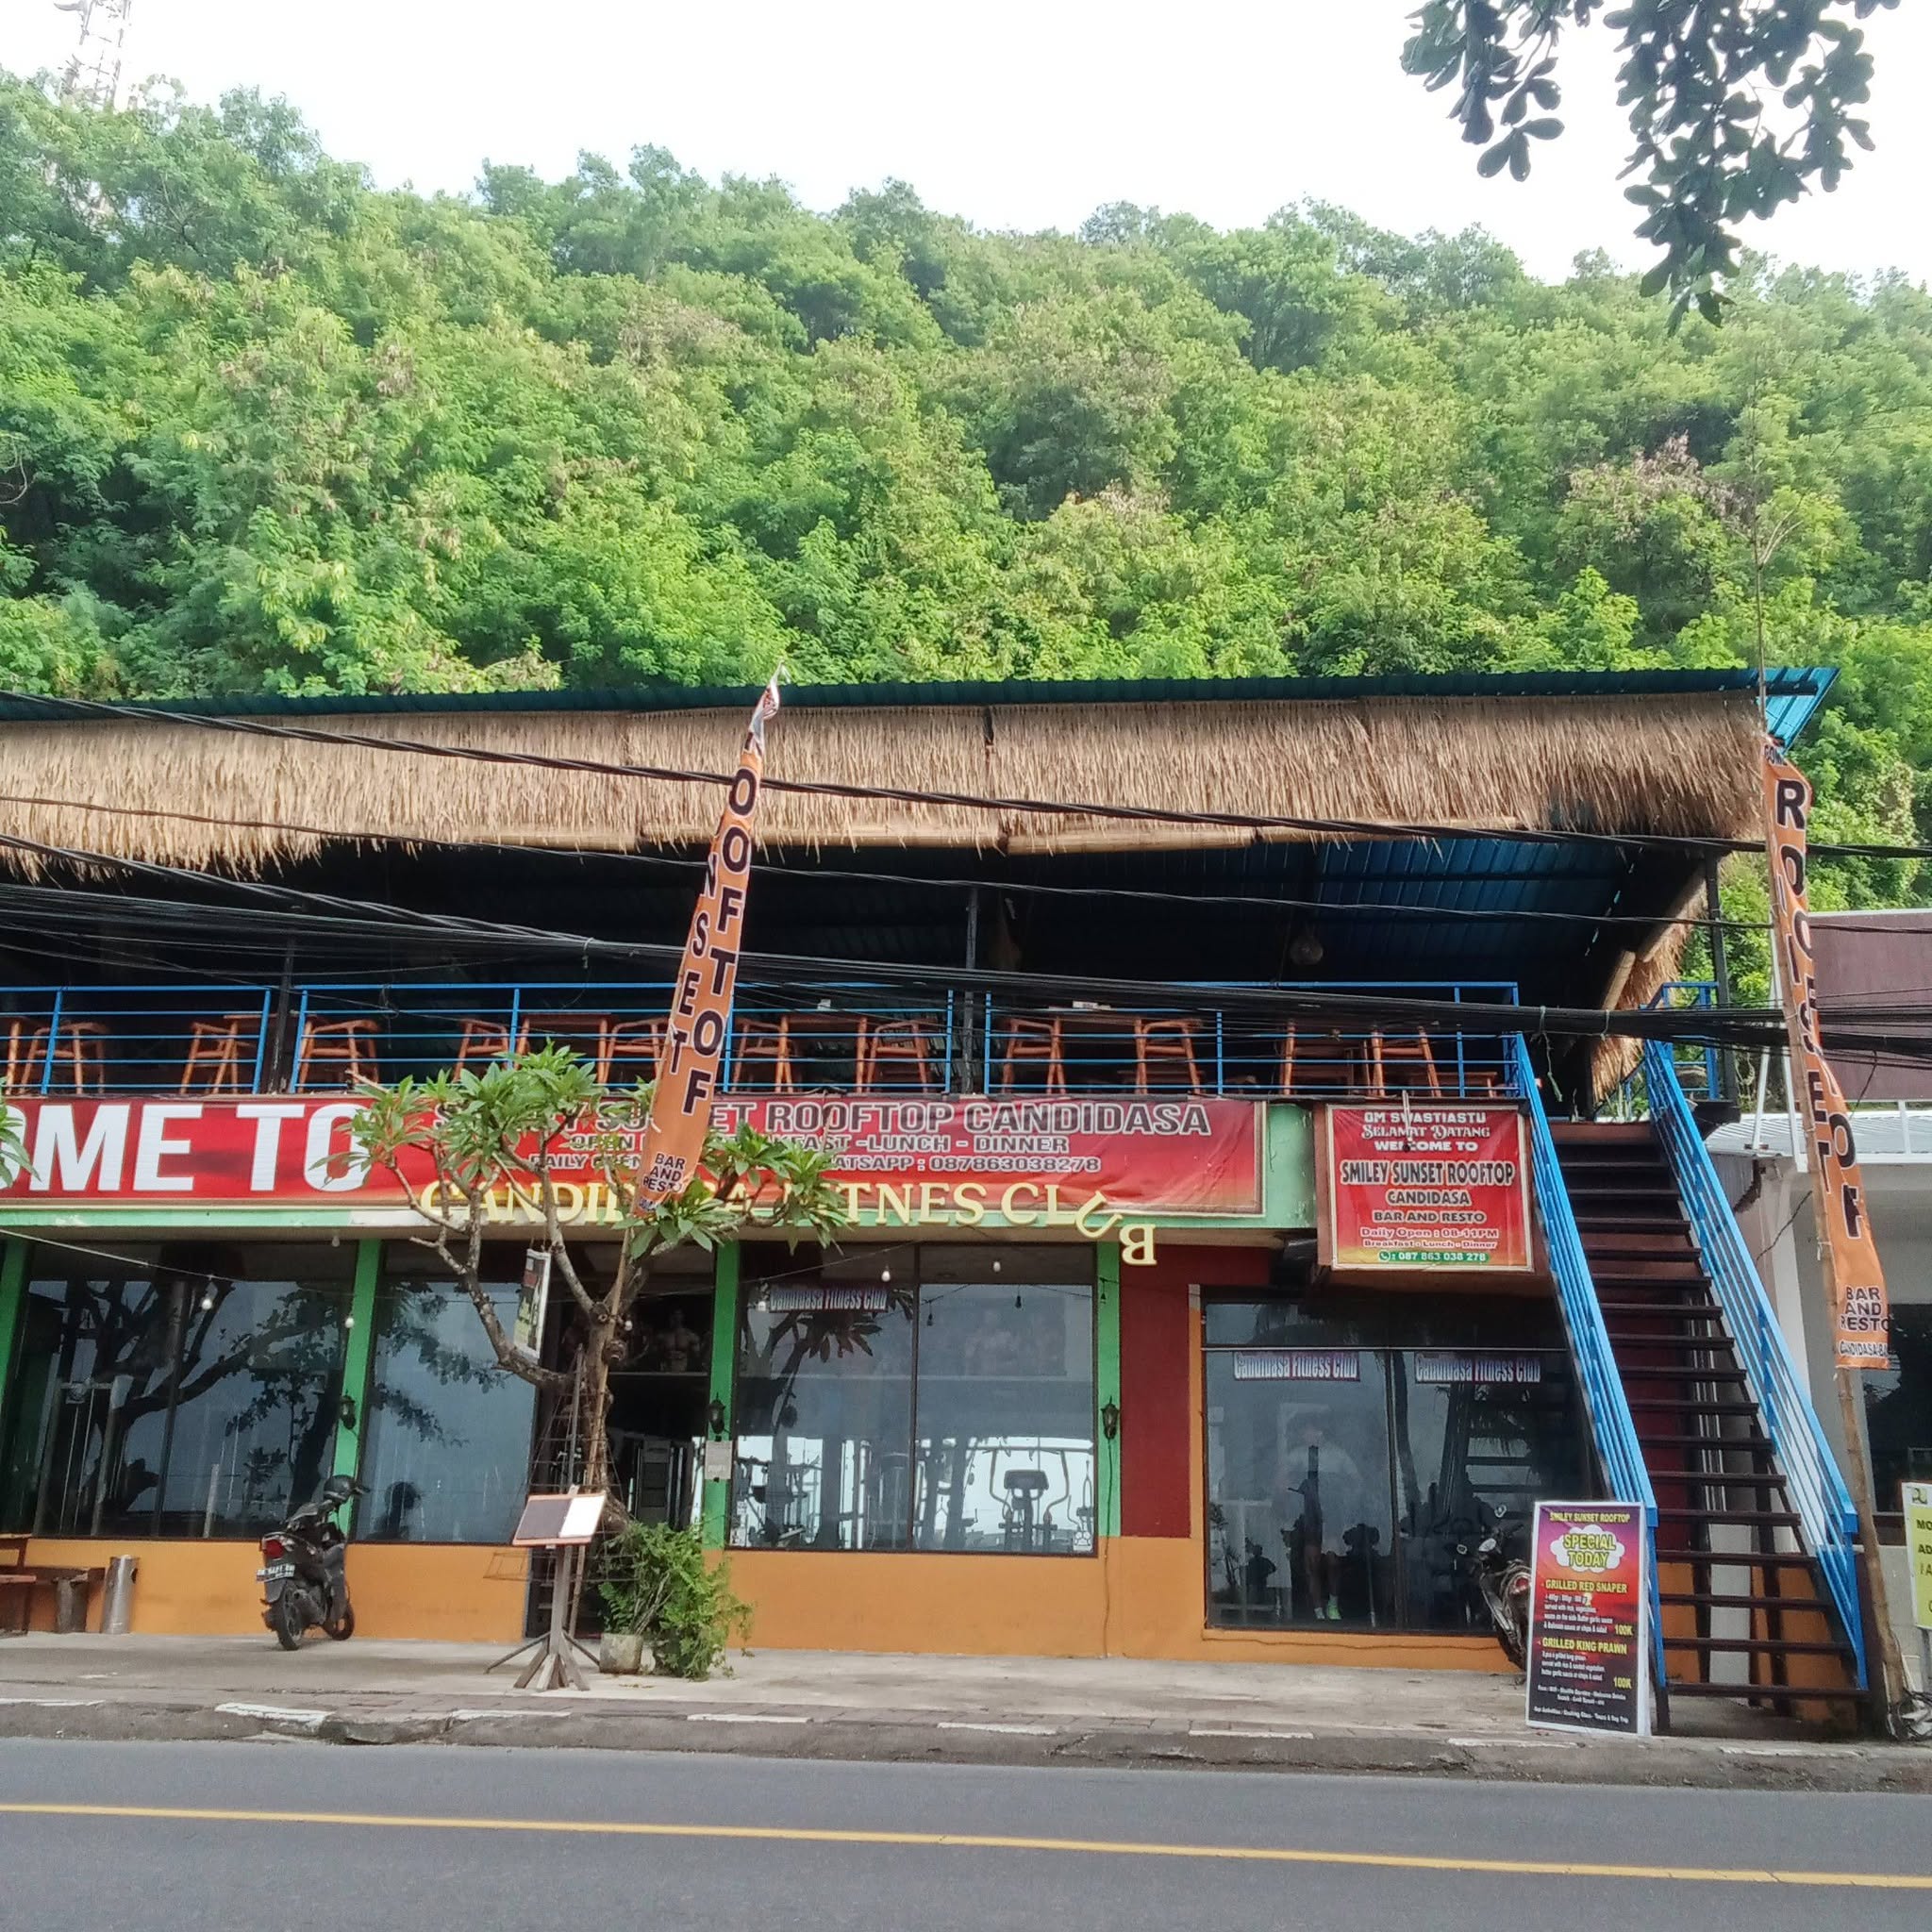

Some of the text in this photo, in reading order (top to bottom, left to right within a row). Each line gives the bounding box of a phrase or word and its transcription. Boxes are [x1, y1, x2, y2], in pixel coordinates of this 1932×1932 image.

[766, 1102, 954, 1133] ROOFTOP
[963, 1102, 1212, 1136] CANDIDASA
[1364, 1112, 1387, 1123] OM
[236, 1103, 375, 1192] TO
[974, 1135, 1070, 1153] DINNER
[1455, 1141, 1479, 1152] TO
[655, 1153, 685, 1170] BAR
[929, 1156, 1101, 1173] 087863038278
[650, 1166, 682, 1182] AND
[1341, 1159, 1515, 1186] SMILEY SUNSET ROOFTOP
[1387, 1189, 1472, 1206] CANDIDASA
[1373, 1210, 1488, 1223] BAR AND RESTO
[1359, 1227, 1394, 1239] Daily
[1396, 1227, 1432, 1239] Open
[1363, 1239, 1414, 1248] Breakfast
[1423, 1240, 1454, 1248] Lunch
[1462, 1240, 1498, 1249] Dinner
[1398, 1252, 1419, 1261] 087
[1846, 1286, 1880, 1301] BAR
[1844, 1302, 1882, 1316] AND
[1563, 1533, 1616, 1550] SPECIAL
[1568, 1551, 1608, 1568] TODAY
[1545, 1579, 1577, 1591] GRILLED
[1578, 1580, 1595, 1592] RED
[1542, 1637, 1627, 1655] GRILLED KING PRAWN
